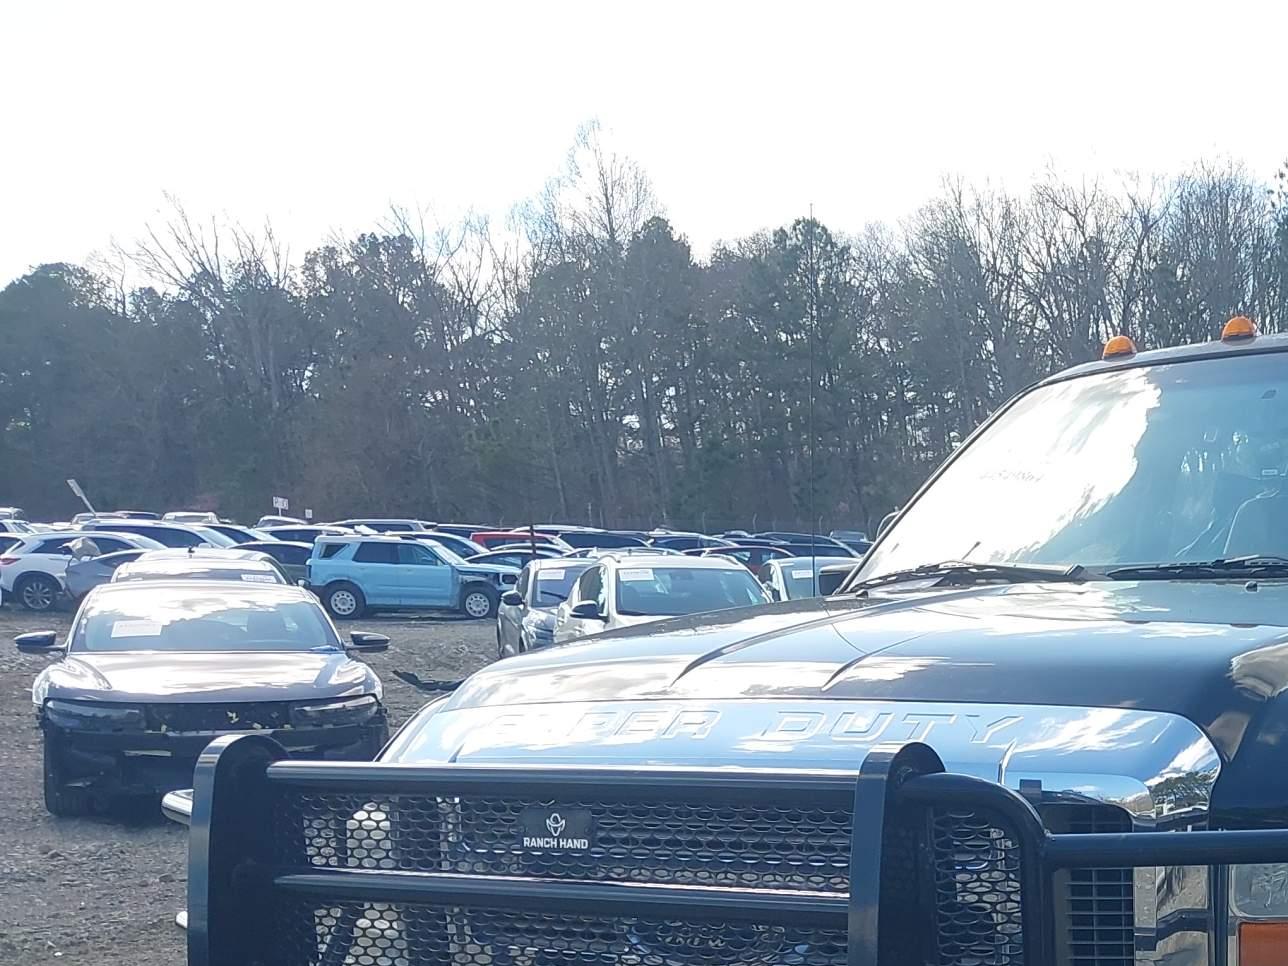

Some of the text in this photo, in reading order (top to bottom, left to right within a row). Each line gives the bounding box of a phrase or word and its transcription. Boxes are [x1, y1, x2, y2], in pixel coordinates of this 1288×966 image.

[759, 709, 1028, 745] DUTY
[523, 837, 589, 849] RANCH HAND
